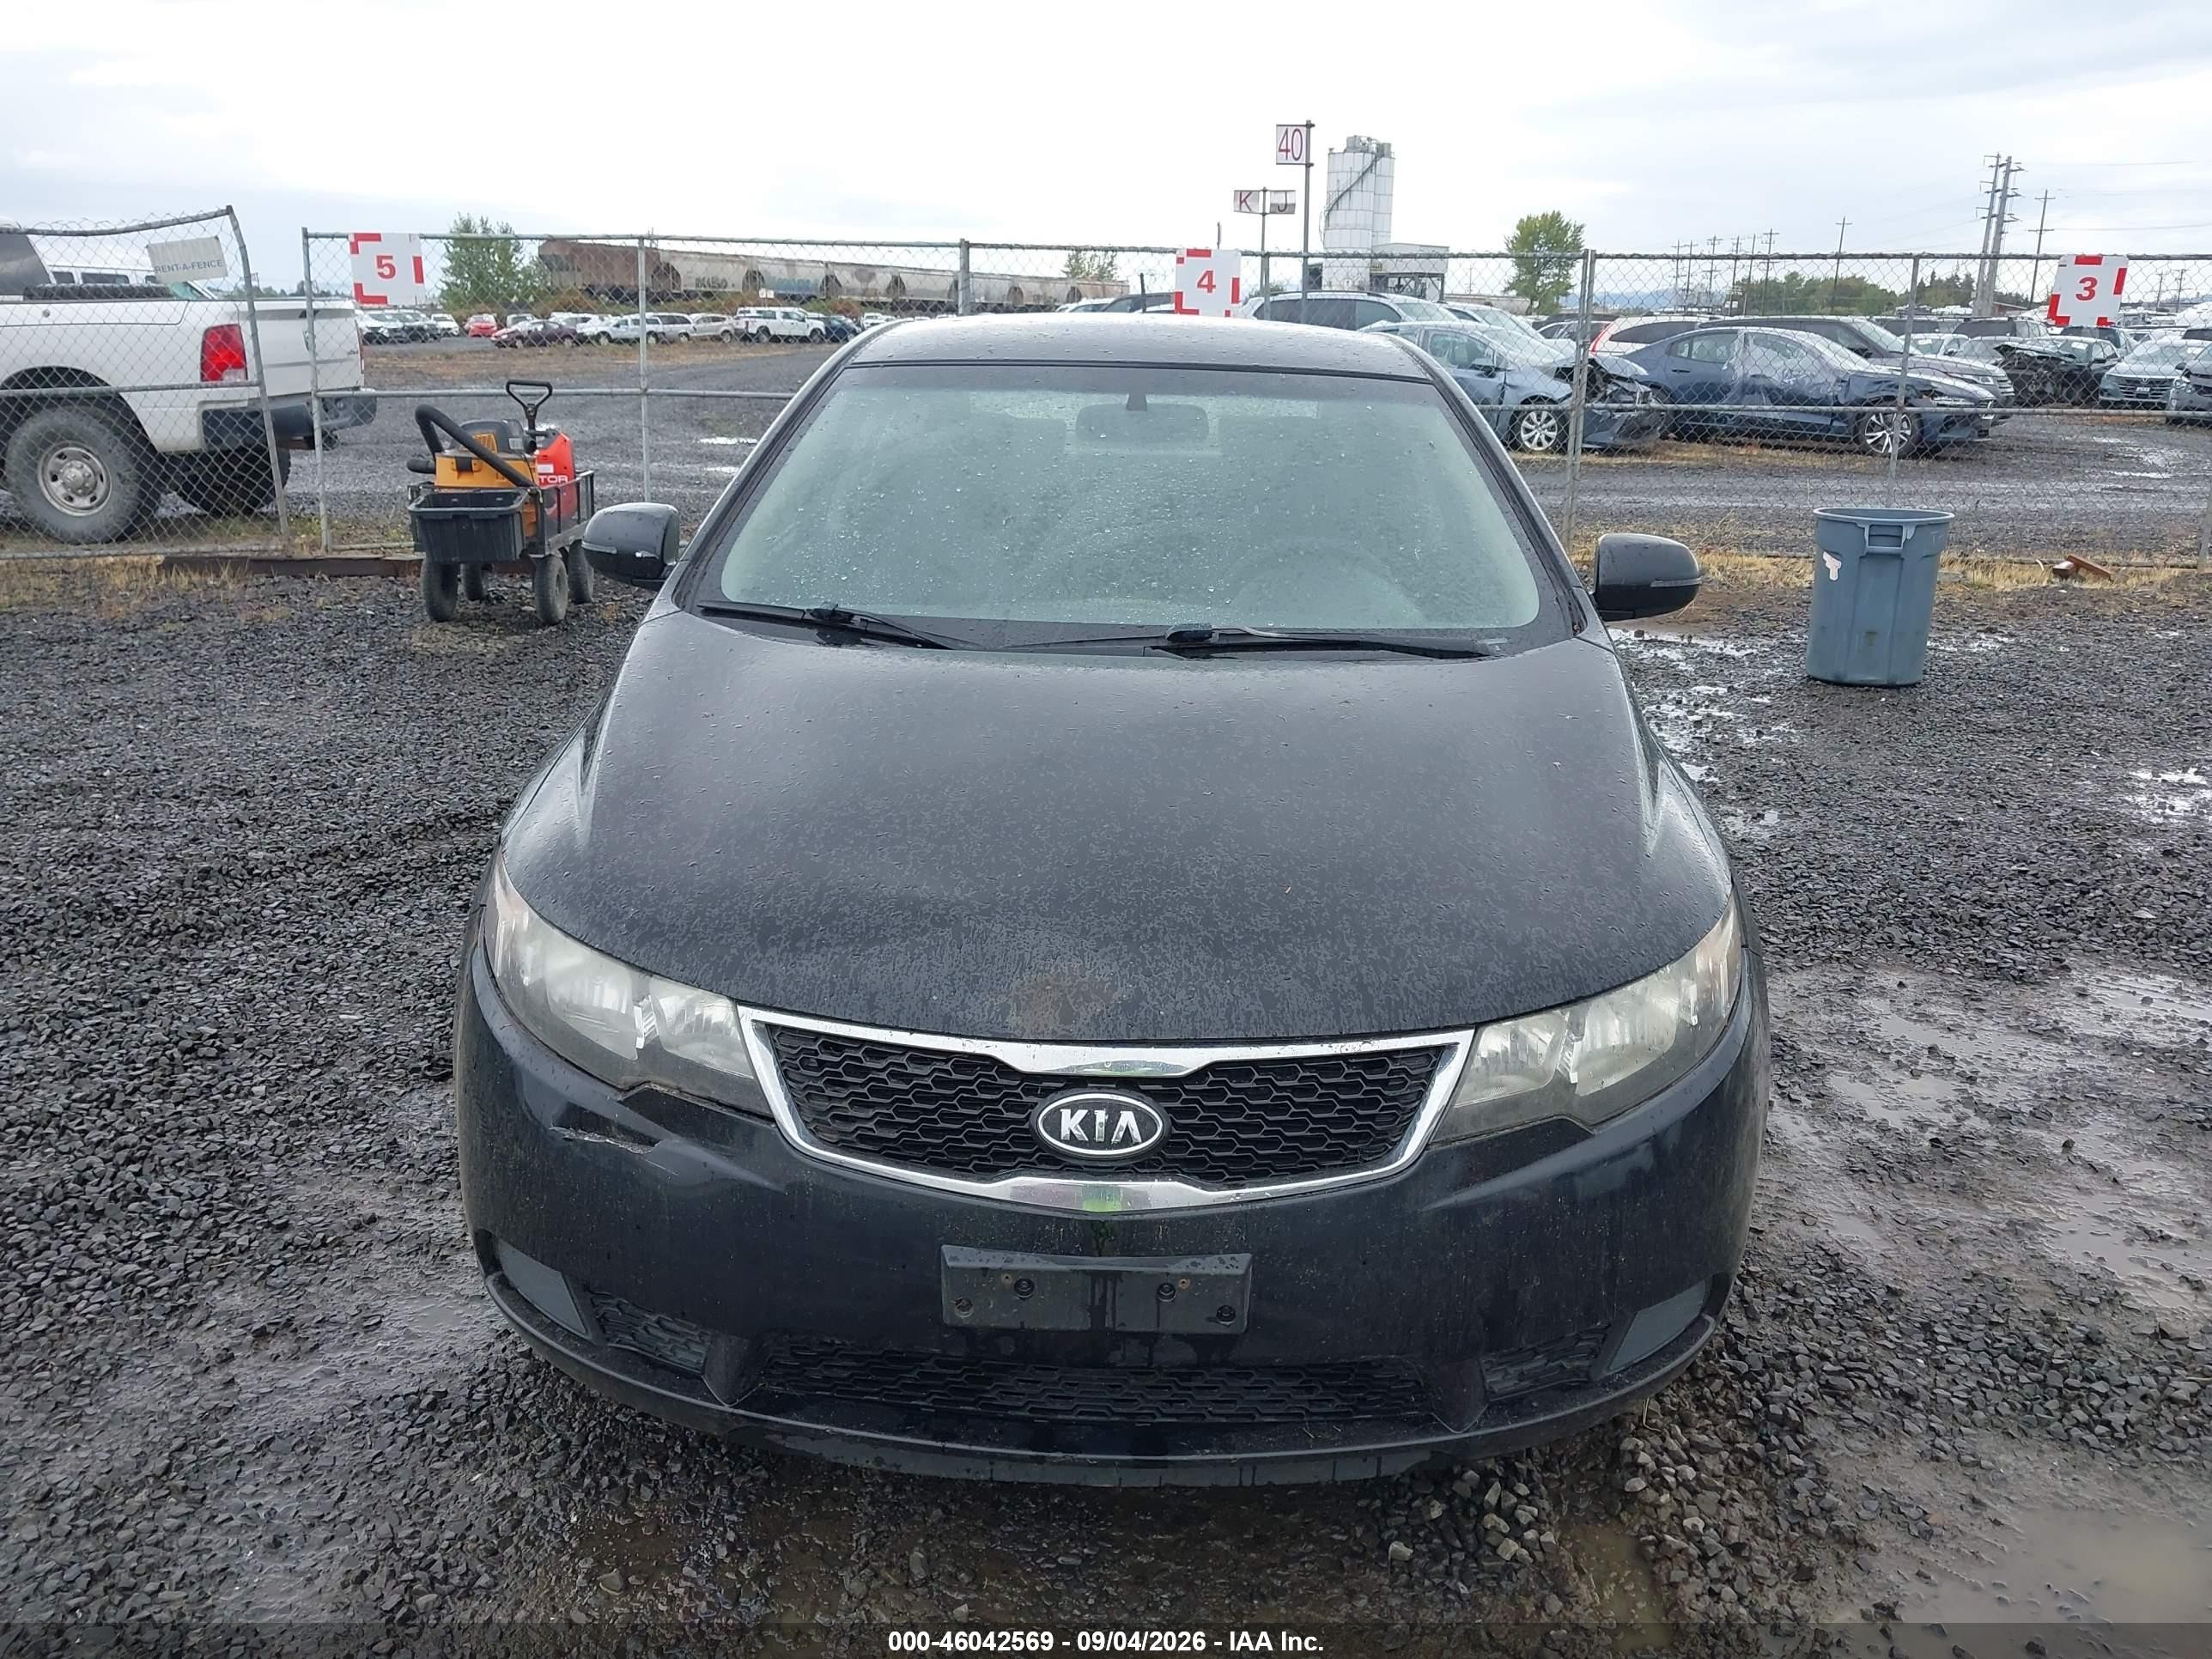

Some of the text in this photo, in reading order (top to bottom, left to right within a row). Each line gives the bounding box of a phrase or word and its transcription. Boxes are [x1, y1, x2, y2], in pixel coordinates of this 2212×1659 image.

[1278, 127, 1304, 161] 40
[1239, 191, 1253, 212] K
[1277, 191, 1288, 213] J
[154, 259, 224, 274] RENT-A-FENCE
[376, 255, 396, 279] 5
[1196, 270, 1217, 294] 4
[2075, 276, 2098, 301] 3
[1060, 1109, 1143, 1145] KIA
